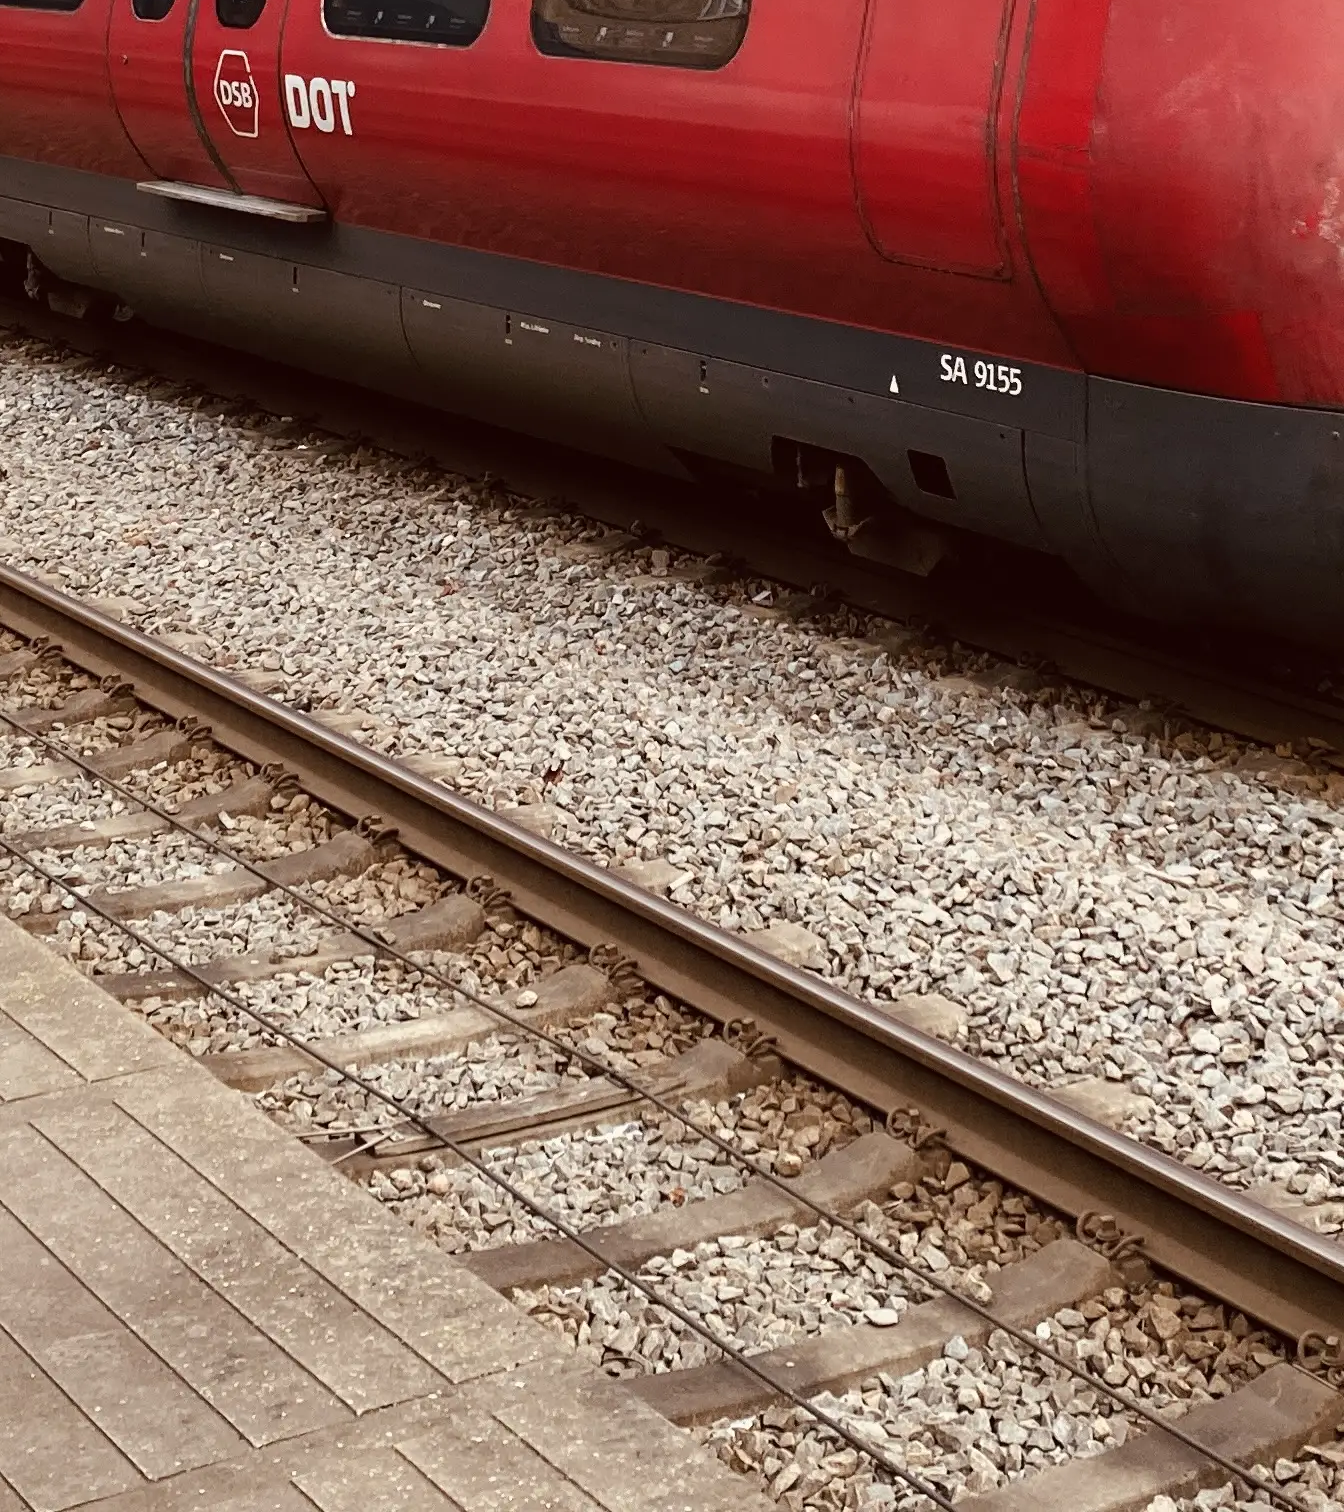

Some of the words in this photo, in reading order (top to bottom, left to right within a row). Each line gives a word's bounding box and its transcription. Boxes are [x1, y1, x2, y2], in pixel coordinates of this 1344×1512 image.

[219, 79, 253, 109] DSB
[284, 73, 356, 136] DOT
[940, 354, 968, 385] SA
[974, 360, 1023, 396] 9155
